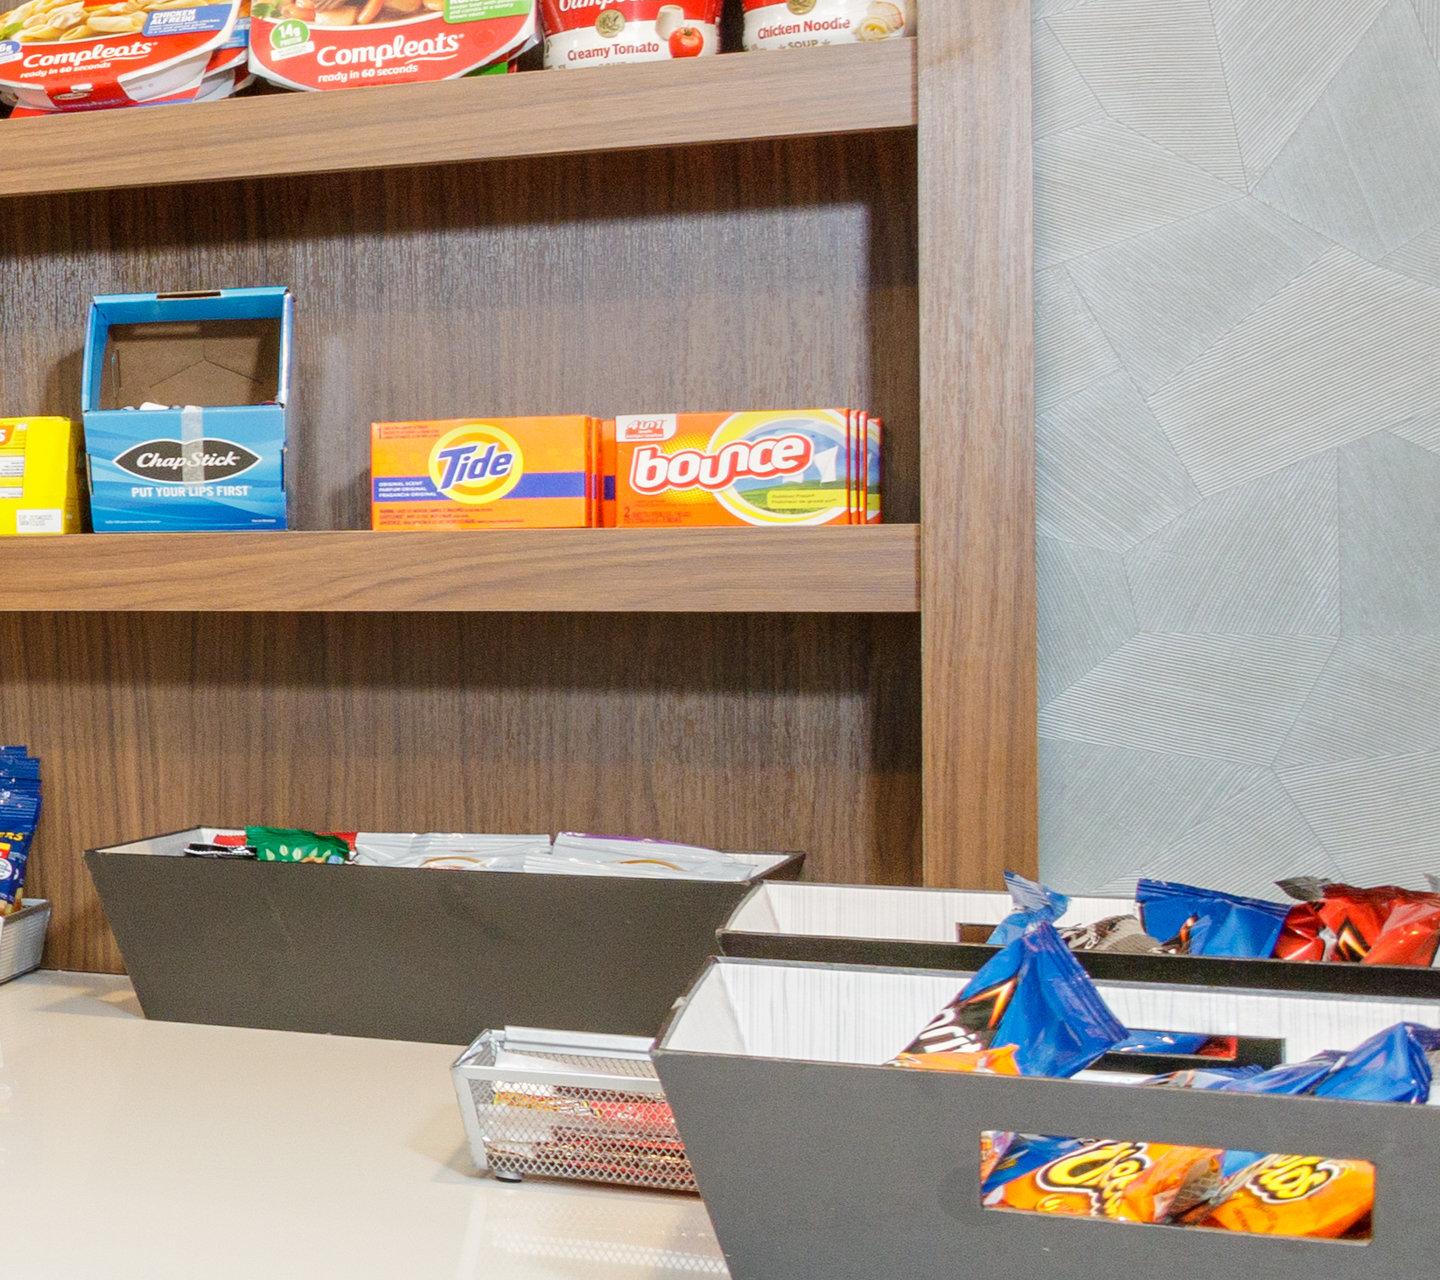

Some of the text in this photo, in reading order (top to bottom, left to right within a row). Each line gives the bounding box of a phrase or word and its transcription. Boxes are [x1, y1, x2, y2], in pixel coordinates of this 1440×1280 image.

[22, 41, 159, 70] Compleats
[317, 32, 460, 69] Compleats
[568, 41, 659, 62] Creamy Tomato
[318, 63, 419, 84] ready in 60 seconds
[436, 447, 512, 492] Tide
[634, 434, 809, 490] bounce
[131, 486, 248, 497] PUT YOUR LIPS FIRST
